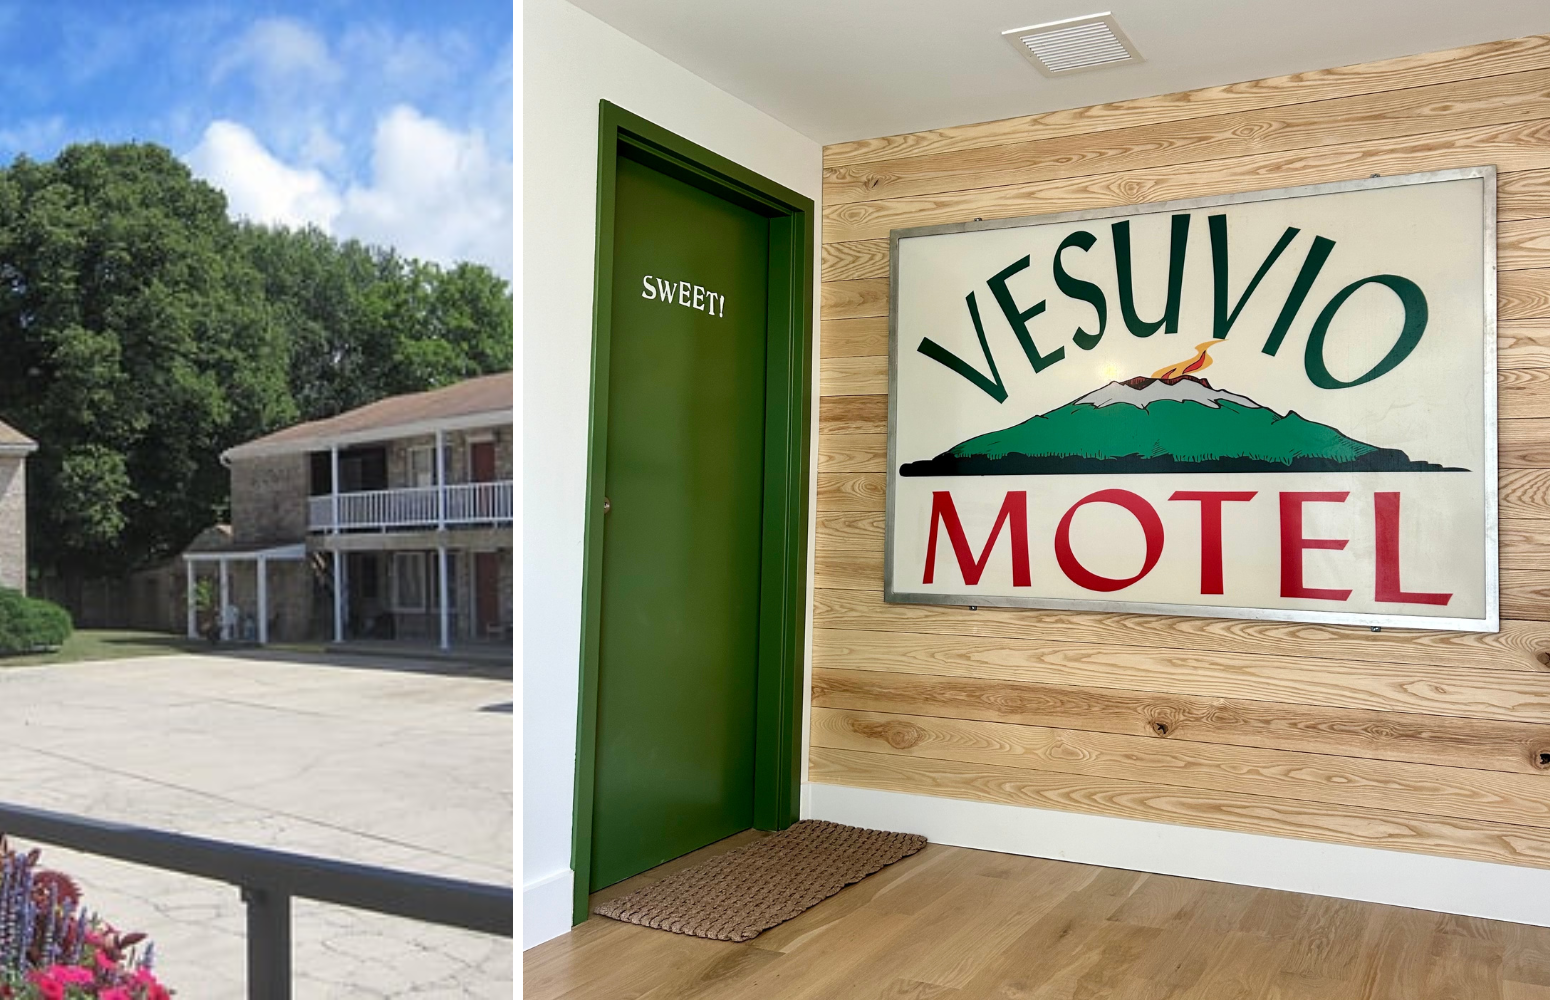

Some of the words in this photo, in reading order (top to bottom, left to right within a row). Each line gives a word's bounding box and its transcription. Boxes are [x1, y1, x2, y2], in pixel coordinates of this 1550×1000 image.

[642, 275, 725, 318] SWEET!
[917, 214, 1429, 404] VESUVIO
[922, 489, 1453, 606] MOTEL
